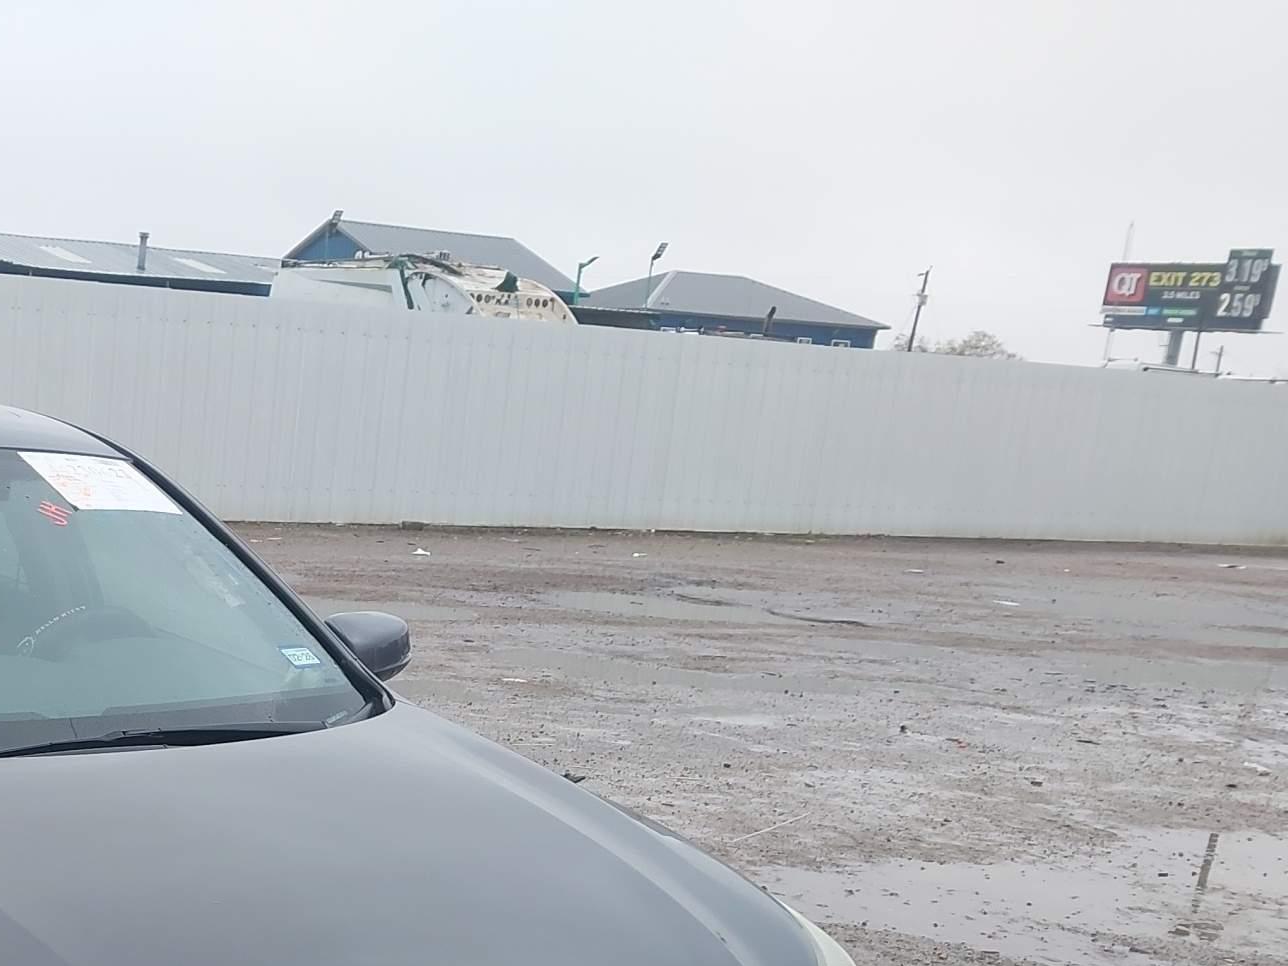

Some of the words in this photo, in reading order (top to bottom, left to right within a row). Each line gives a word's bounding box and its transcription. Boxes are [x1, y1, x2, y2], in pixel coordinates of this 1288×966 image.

[1113, 272, 1142, 297] QT
[1148, 271, 1188, 287] EXIT
[1188, 272, 1222, 287] 273
